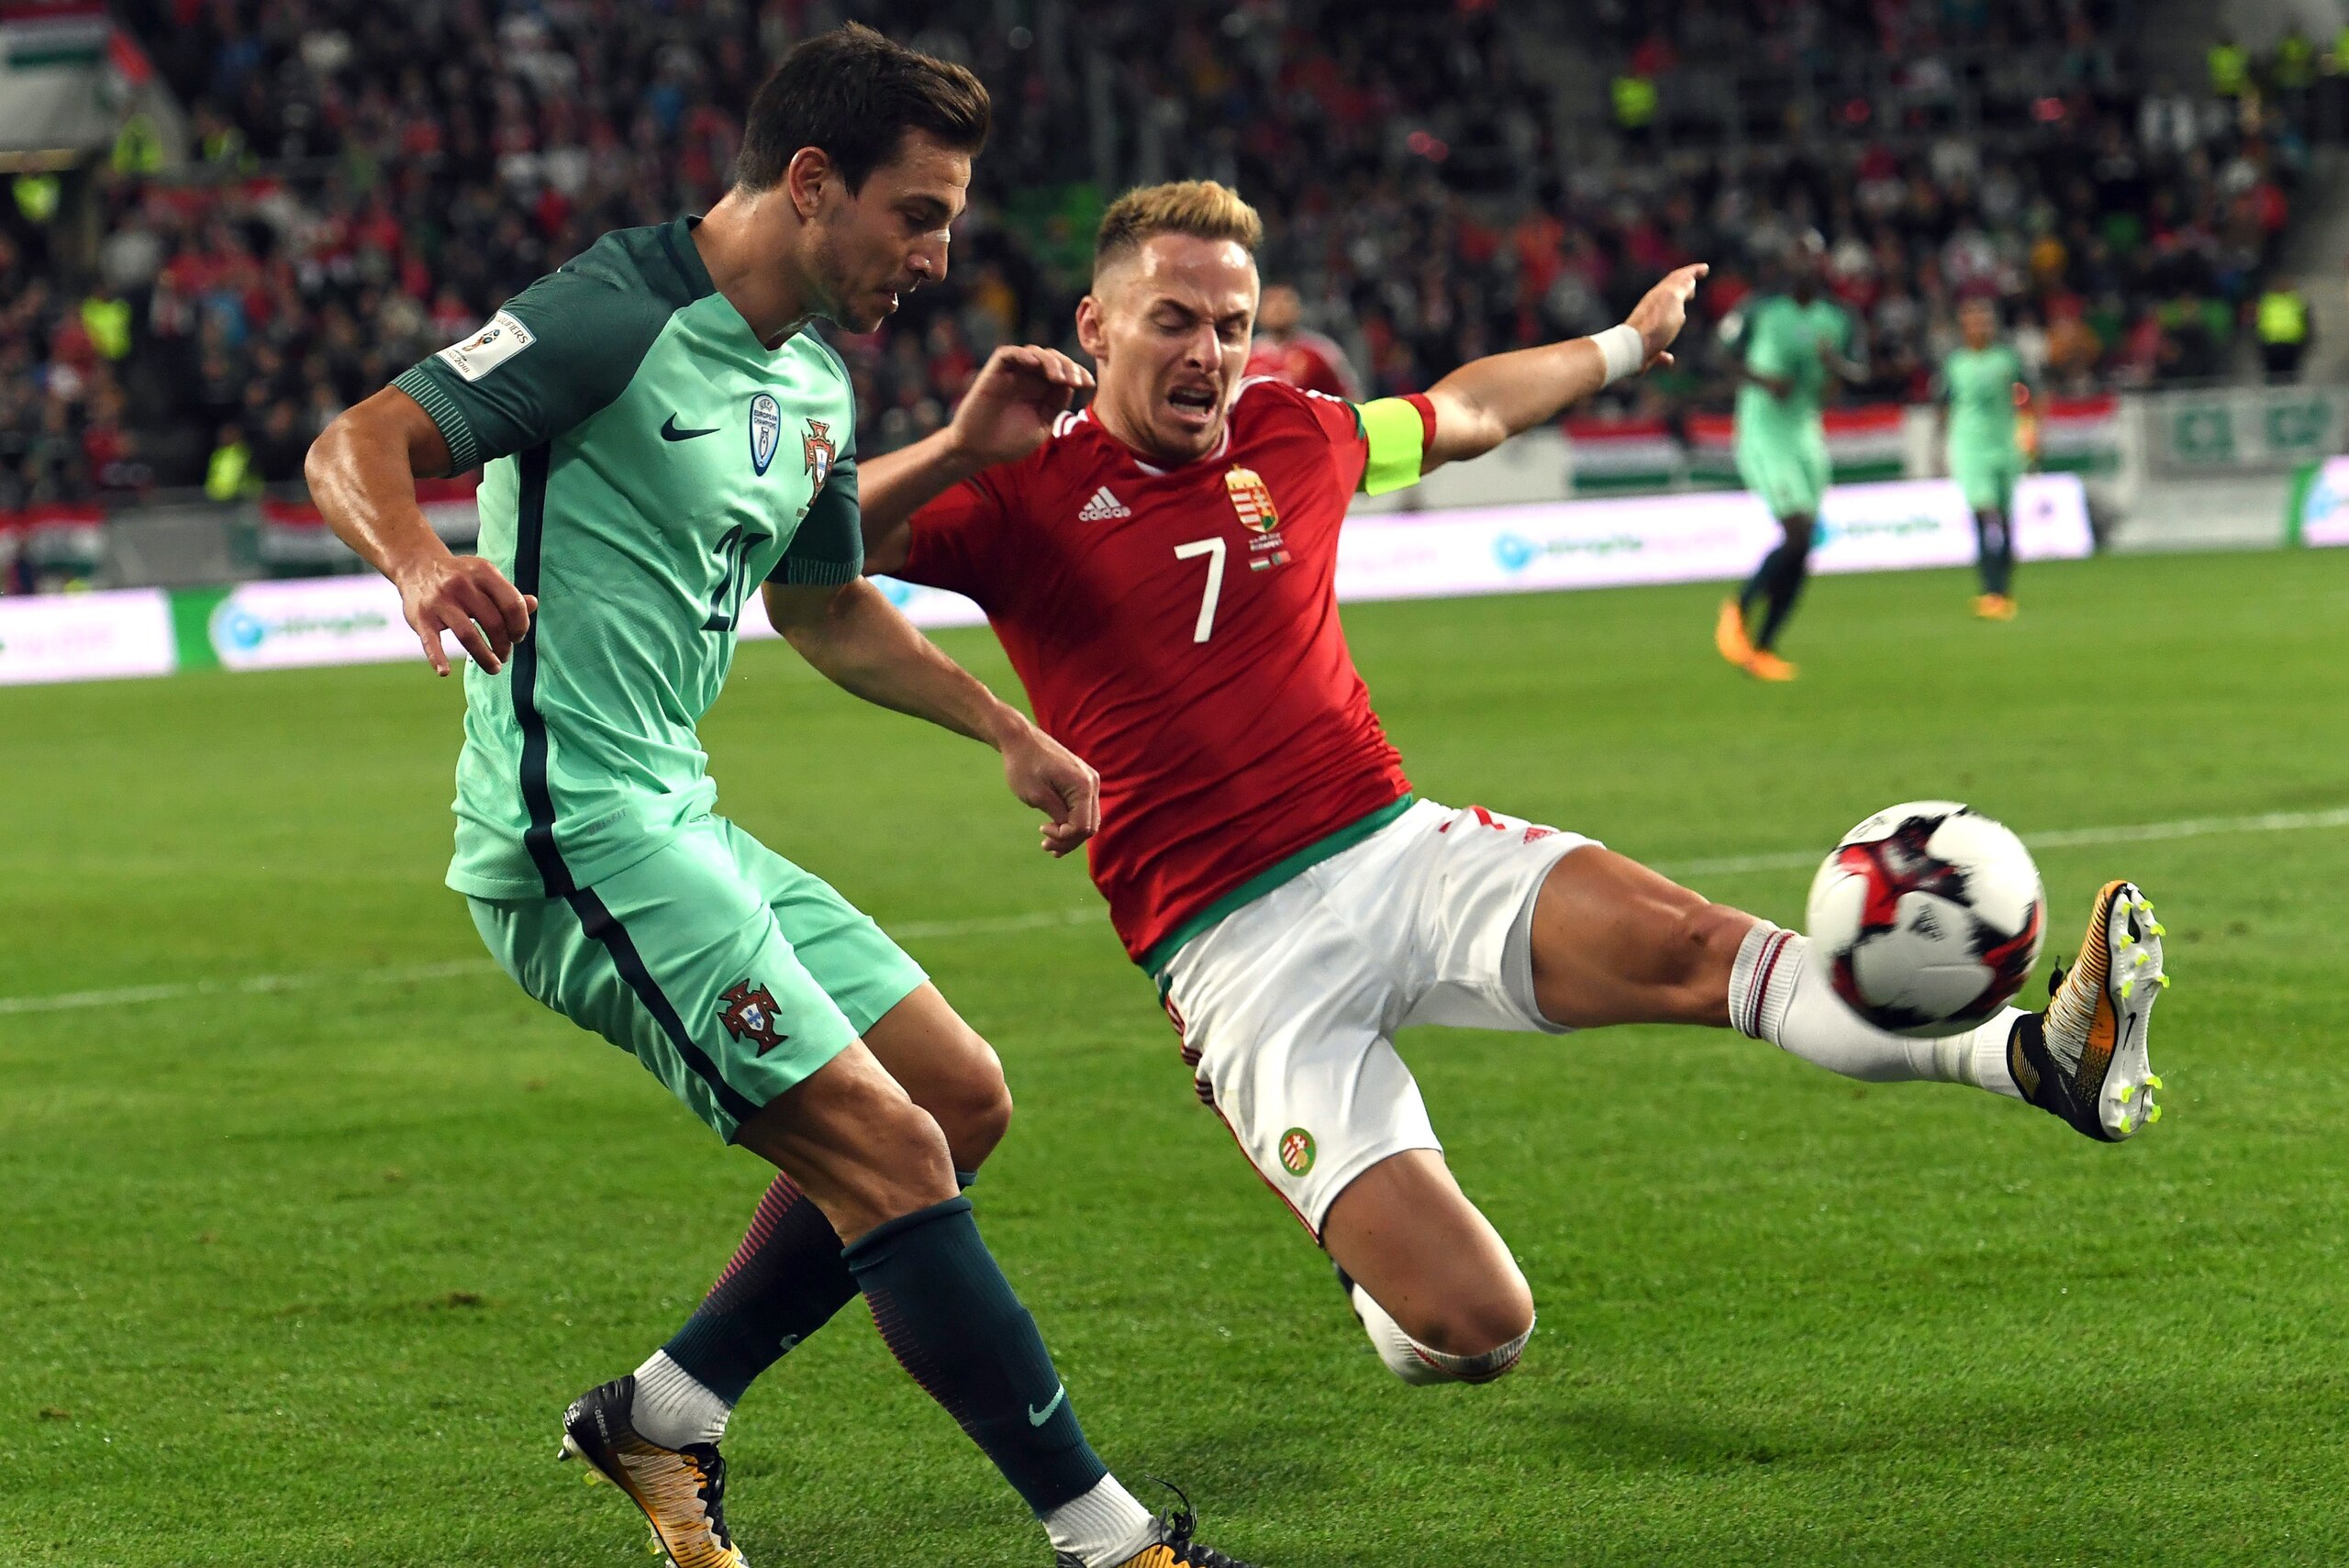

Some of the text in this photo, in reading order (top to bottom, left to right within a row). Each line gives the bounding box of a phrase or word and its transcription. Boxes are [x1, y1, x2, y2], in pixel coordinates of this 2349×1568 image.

[1078, 506, 1131, 522] adidas
[700, 524, 773, 632] 21
[1174, 536, 1227, 643] 7
